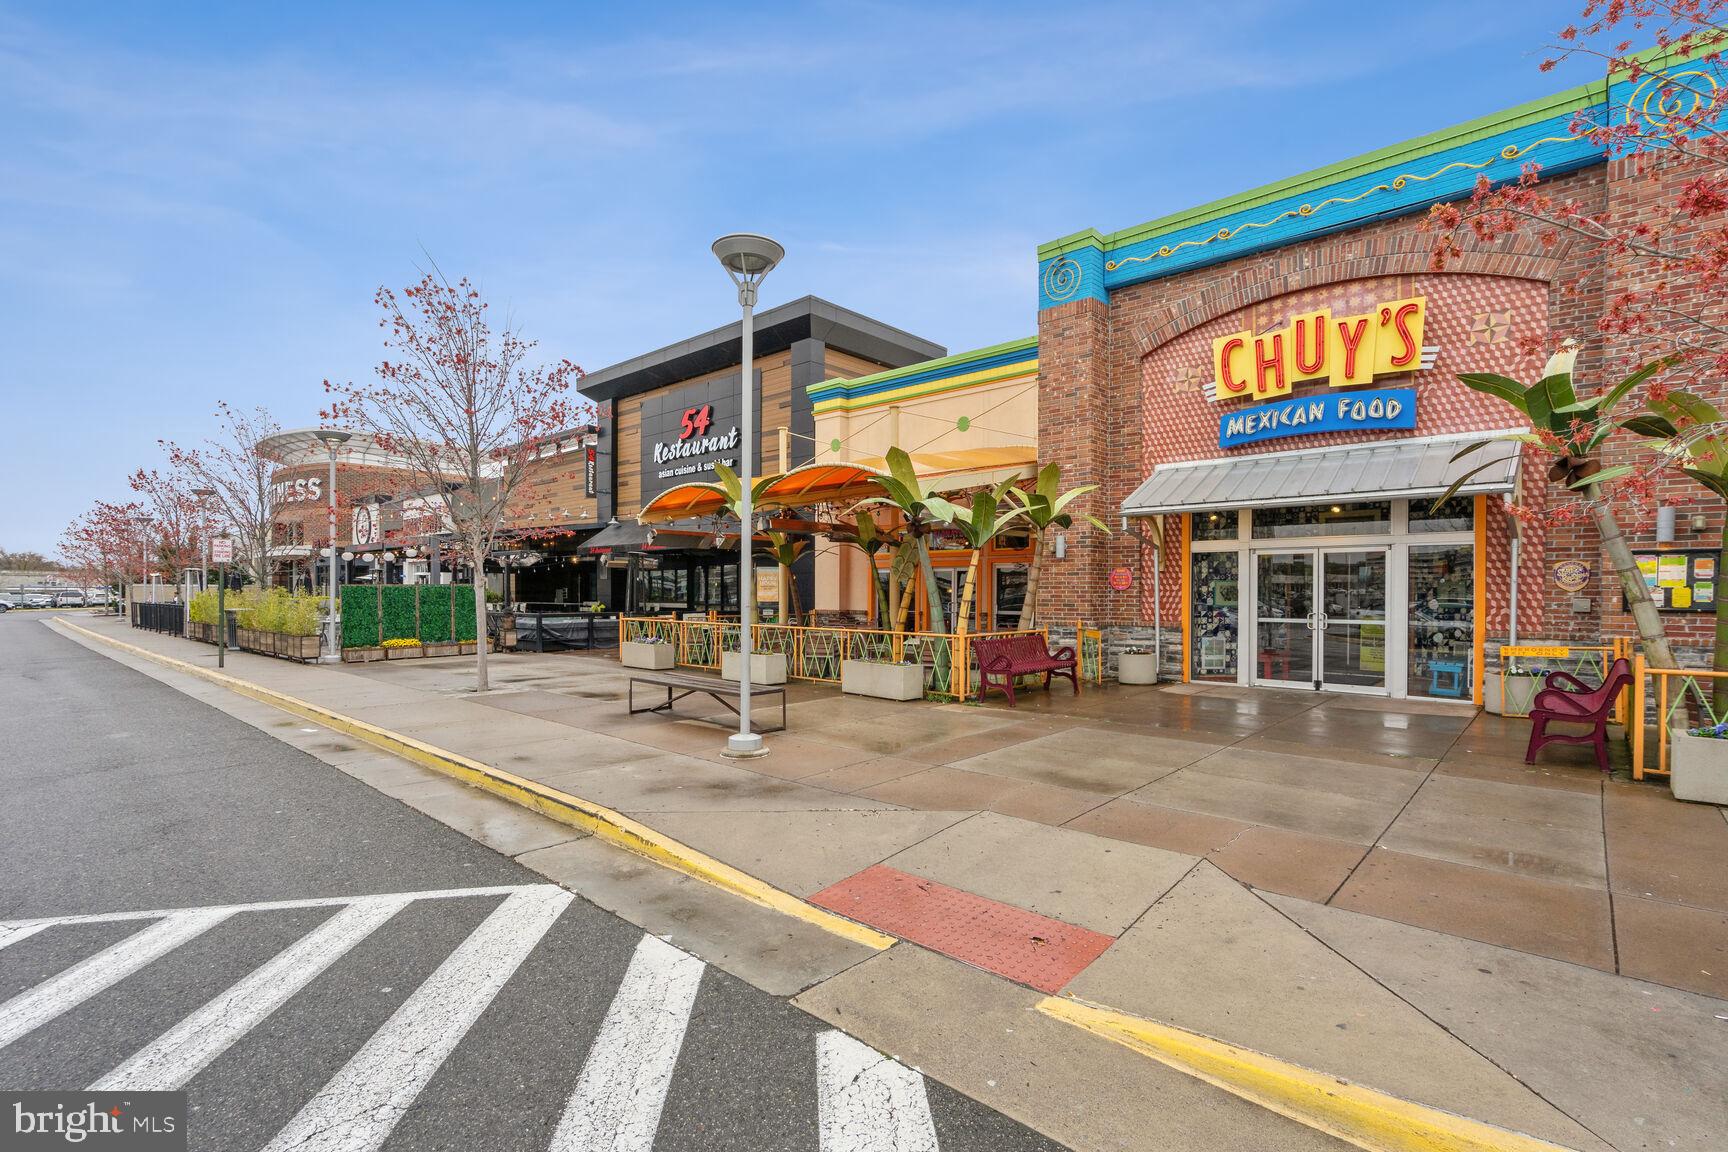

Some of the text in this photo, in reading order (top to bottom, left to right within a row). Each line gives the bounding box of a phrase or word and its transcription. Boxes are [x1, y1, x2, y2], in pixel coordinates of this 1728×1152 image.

[1220, 303, 1418, 392] CHUY'S
[679, 404, 710, 440] 54
[1226, 397, 1402, 438] MEXICAN FOOD
[653, 426, 738, 464] Restaurant
[658, 468, 674, 478] asian
[674, 463, 696, 475] cuisine
[697, 462, 703, 472] &
